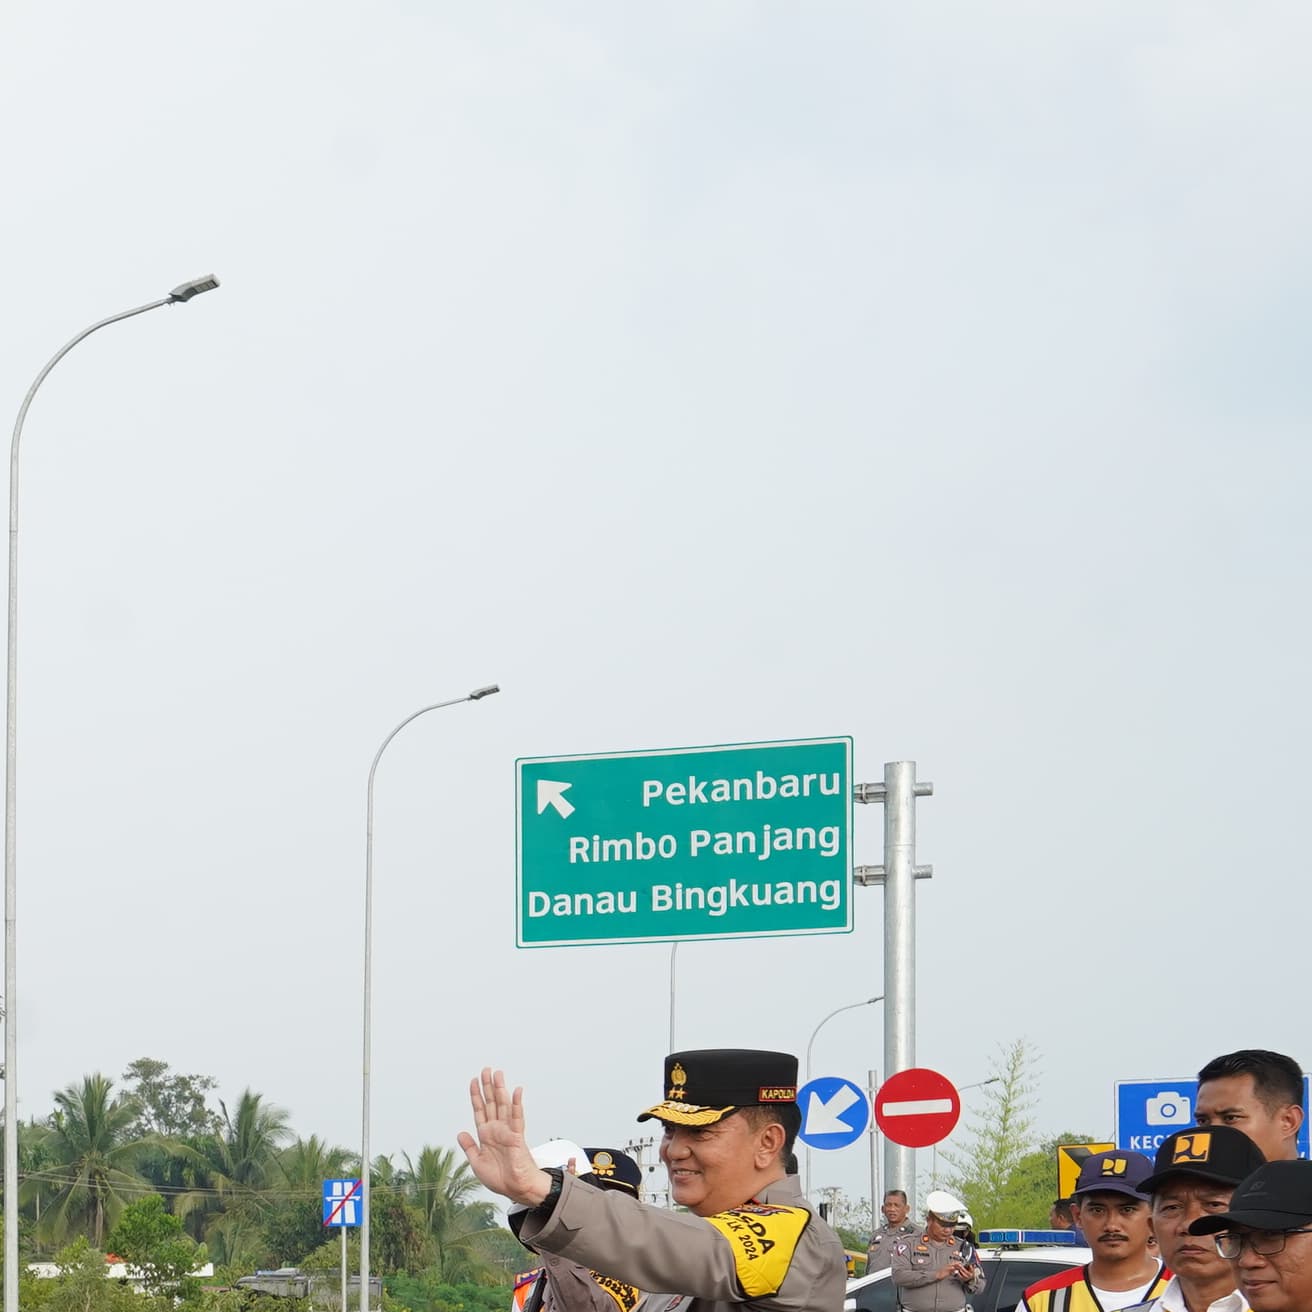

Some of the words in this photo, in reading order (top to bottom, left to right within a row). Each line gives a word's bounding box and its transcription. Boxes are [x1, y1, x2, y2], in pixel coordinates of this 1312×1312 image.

[642, 770, 841, 807] Pekanbaru
[690, 824, 840, 861] Panjang
[528, 890, 637, 917] Danau
[651, 878, 841, 916] Bingkuang
[761, 1088, 795, 1099] KAPOLDA
